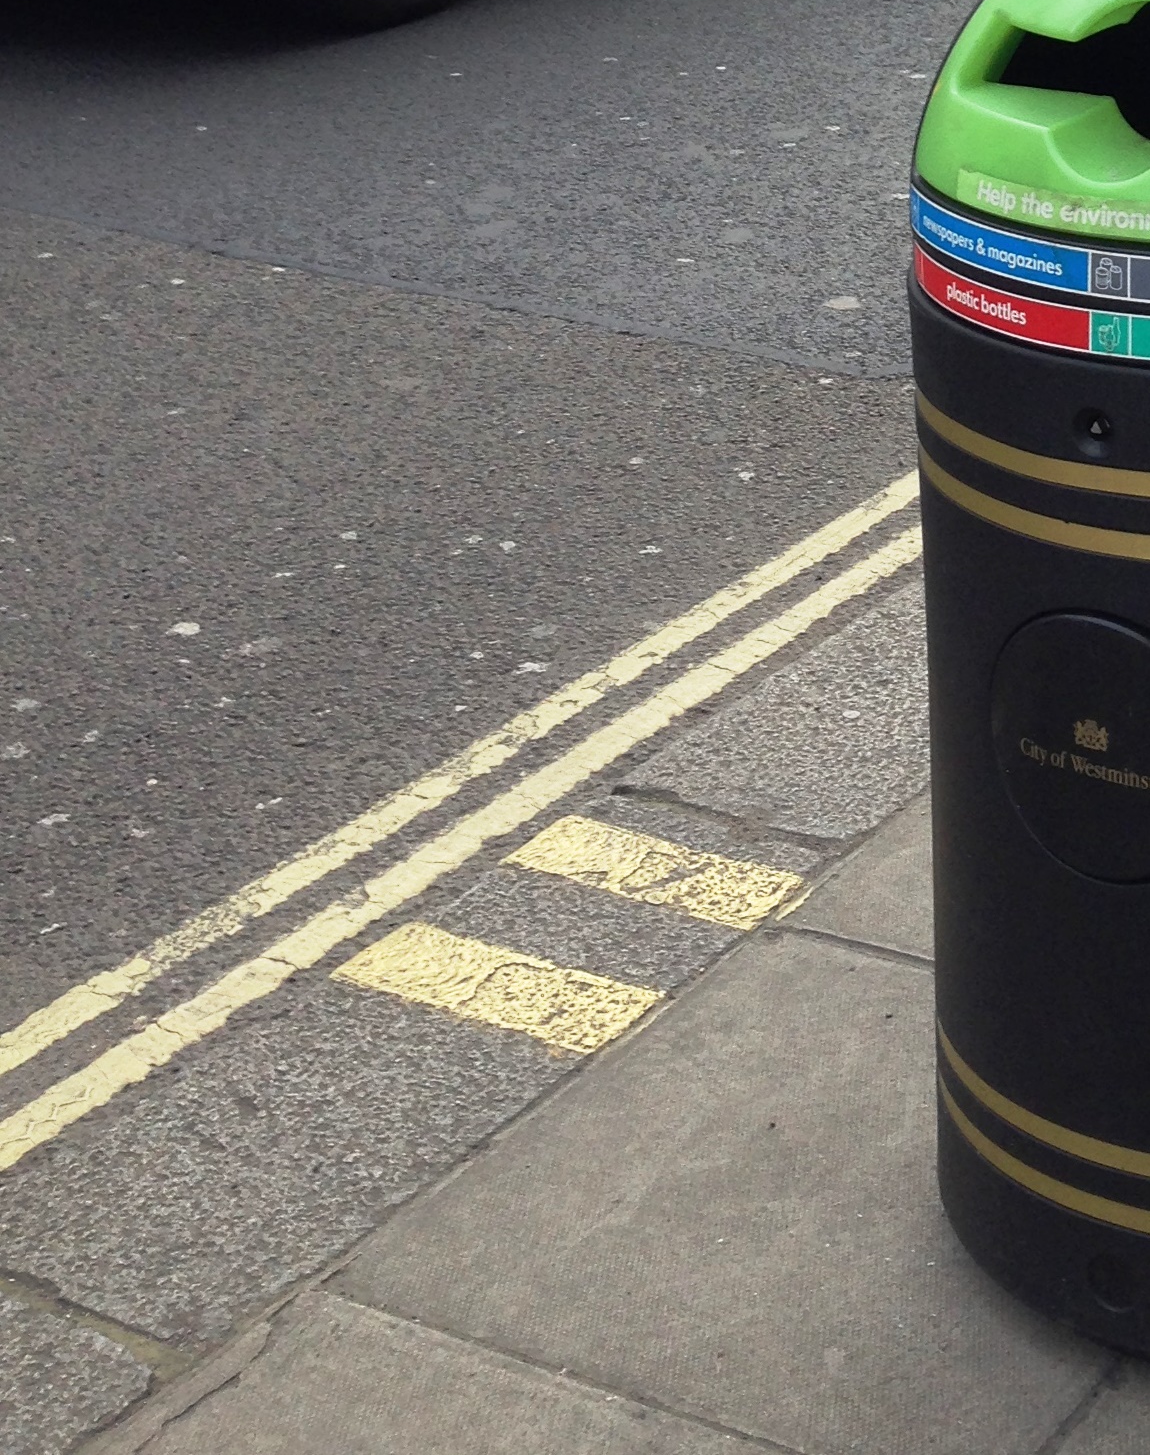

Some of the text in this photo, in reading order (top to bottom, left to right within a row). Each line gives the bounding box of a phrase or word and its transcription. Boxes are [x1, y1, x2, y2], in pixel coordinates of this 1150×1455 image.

[976, 180, 1016, 214] Help
[1022, 192, 1054, 219] the
[922, 215, 1063, 276] newspapers & magazines
[946, 282, 1027, 325] plastic bottles
[1020, 737, 1048, 766] City
[1050, 750, 1068, 769] of
